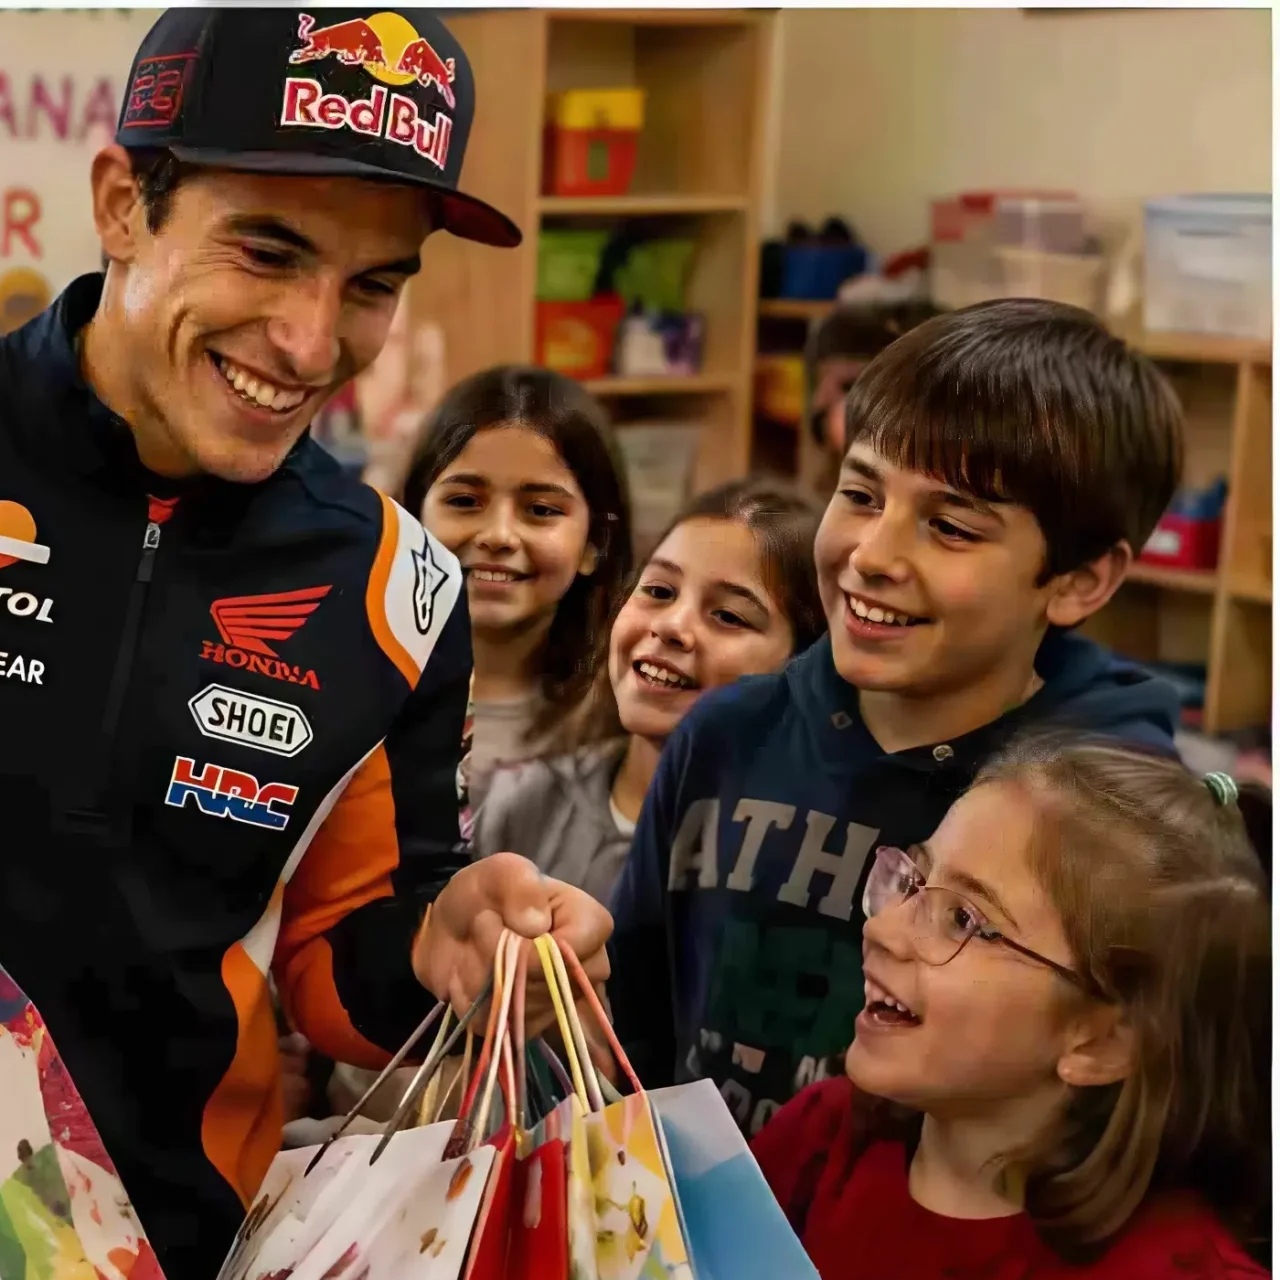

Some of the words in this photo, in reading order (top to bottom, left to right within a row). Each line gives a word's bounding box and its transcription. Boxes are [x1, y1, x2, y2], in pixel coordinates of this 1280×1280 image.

[280, 77, 387, 137] Red
[386, 93, 454, 171] Bull
[199, 640, 321, 690] HONDA
[207, 696, 297, 745] SHOEI
[164, 755, 300, 831] HRC
